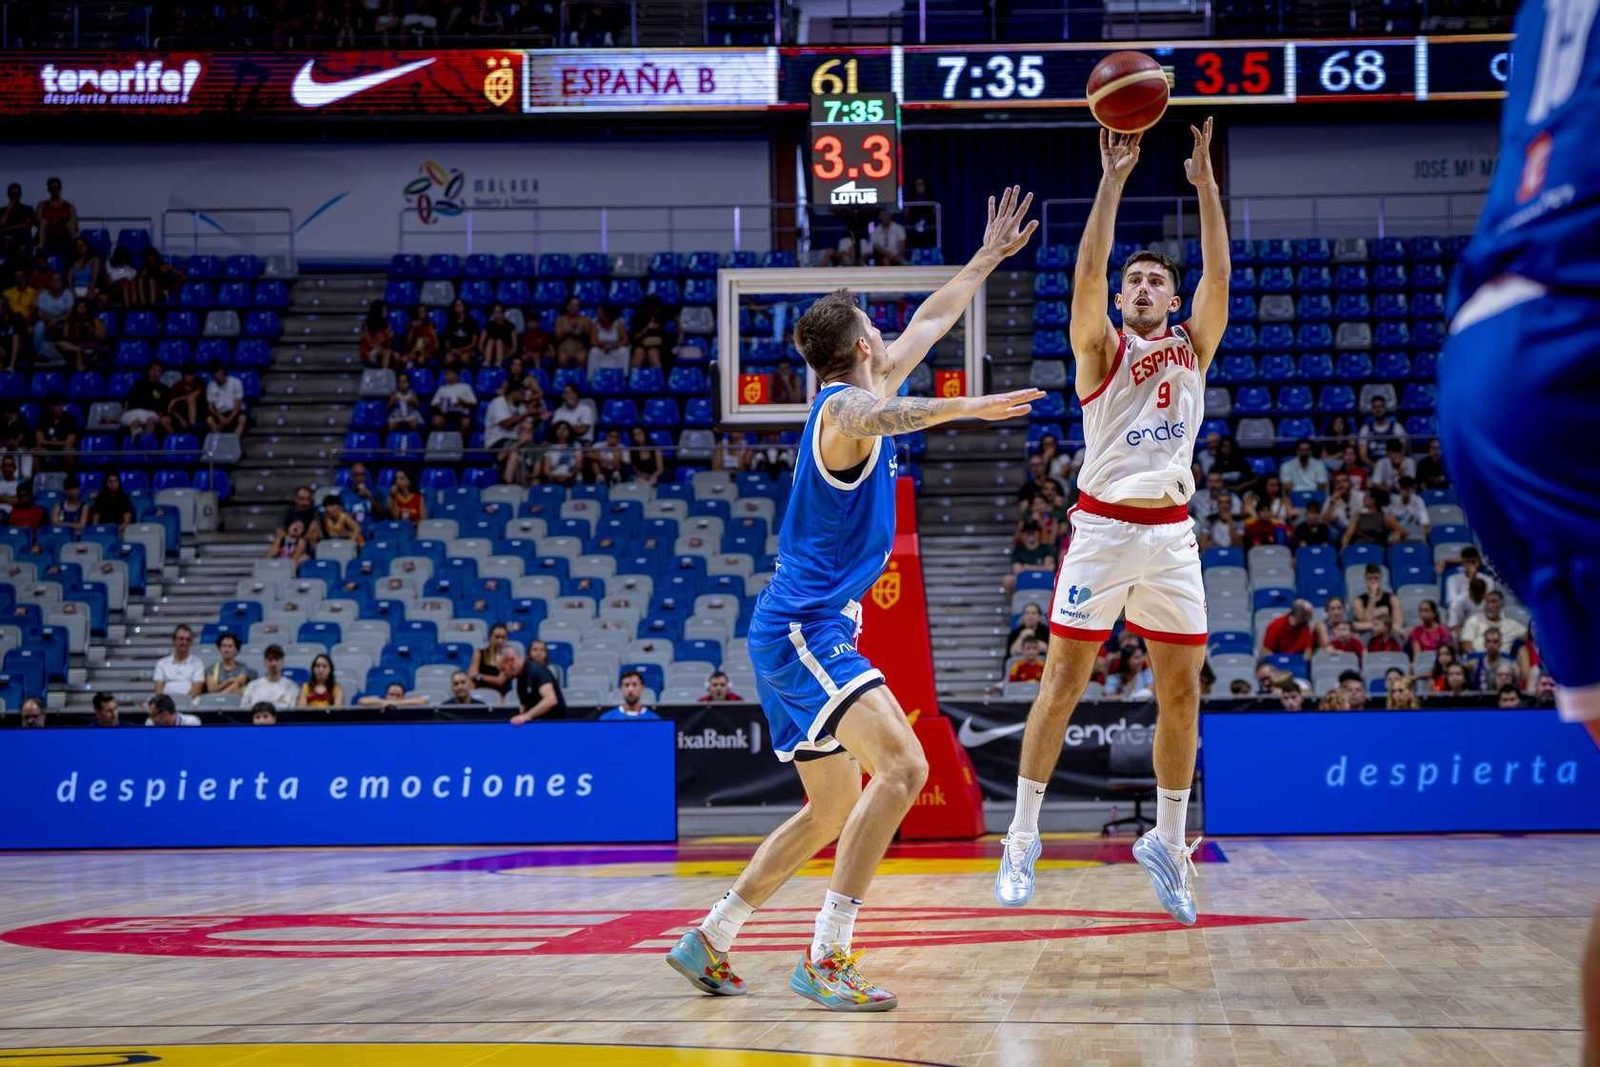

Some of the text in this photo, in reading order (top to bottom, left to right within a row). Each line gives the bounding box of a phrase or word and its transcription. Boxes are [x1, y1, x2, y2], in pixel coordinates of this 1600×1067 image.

[41, 59, 202, 103] tenerife!
[561, 62, 717, 96] ESPAÑA B
[811, 58, 859, 94] 61
[937, 55, 1046, 99] 7:35
[1194, 51, 1271, 94] 3.5
[1318, 50, 1387, 92] 68
[823, 99, 884, 123] 7:35
[814, 135, 892, 179] 3.3
[1414, 157, 1448, 178] JOSÉ
[830, 191, 878, 205] LOTUS
[1156, 381, 1172, 409] 9
[676, 728, 750, 750] ixaBank
[56, 766, 594, 807] despierta emociones
[1326, 754, 1579, 792] despierta
